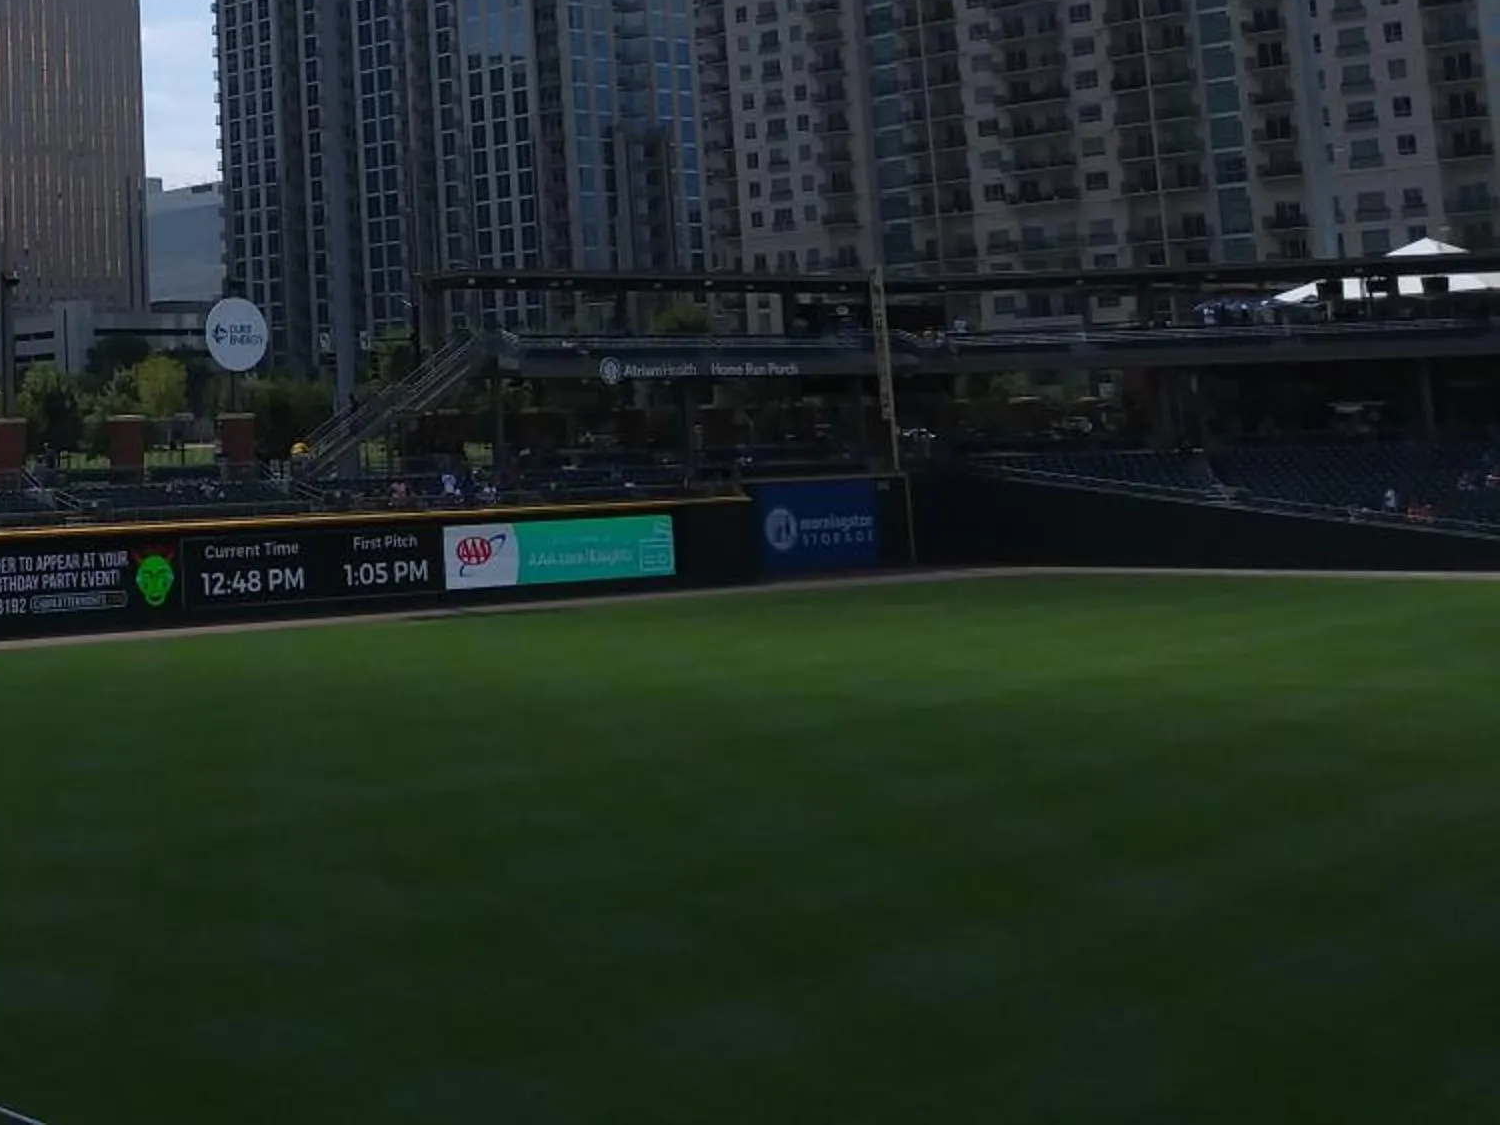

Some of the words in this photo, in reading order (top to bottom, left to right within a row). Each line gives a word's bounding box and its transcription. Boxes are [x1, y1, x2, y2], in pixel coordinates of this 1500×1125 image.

[204, 542, 261, 559] Current
[264, 541, 299, 557] Time
[353, 536, 381, 551] First
[384, 534, 418, 549] Pitch
[458, 537, 491, 559] AAA
[19, 556, 33, 573] TO
[36, 553, 80, 572] APPEAR
[82, 552, 97, 569] AT
[99, 550, 129, 568] YOUR
[42, 572, 78, 590] PARTY
[201, 569, 262, 596] 12:48
[268, 567, 305, 592] PM
[343, 562, 389, 586] 1:05
[394, 560, 429, 583] PM
